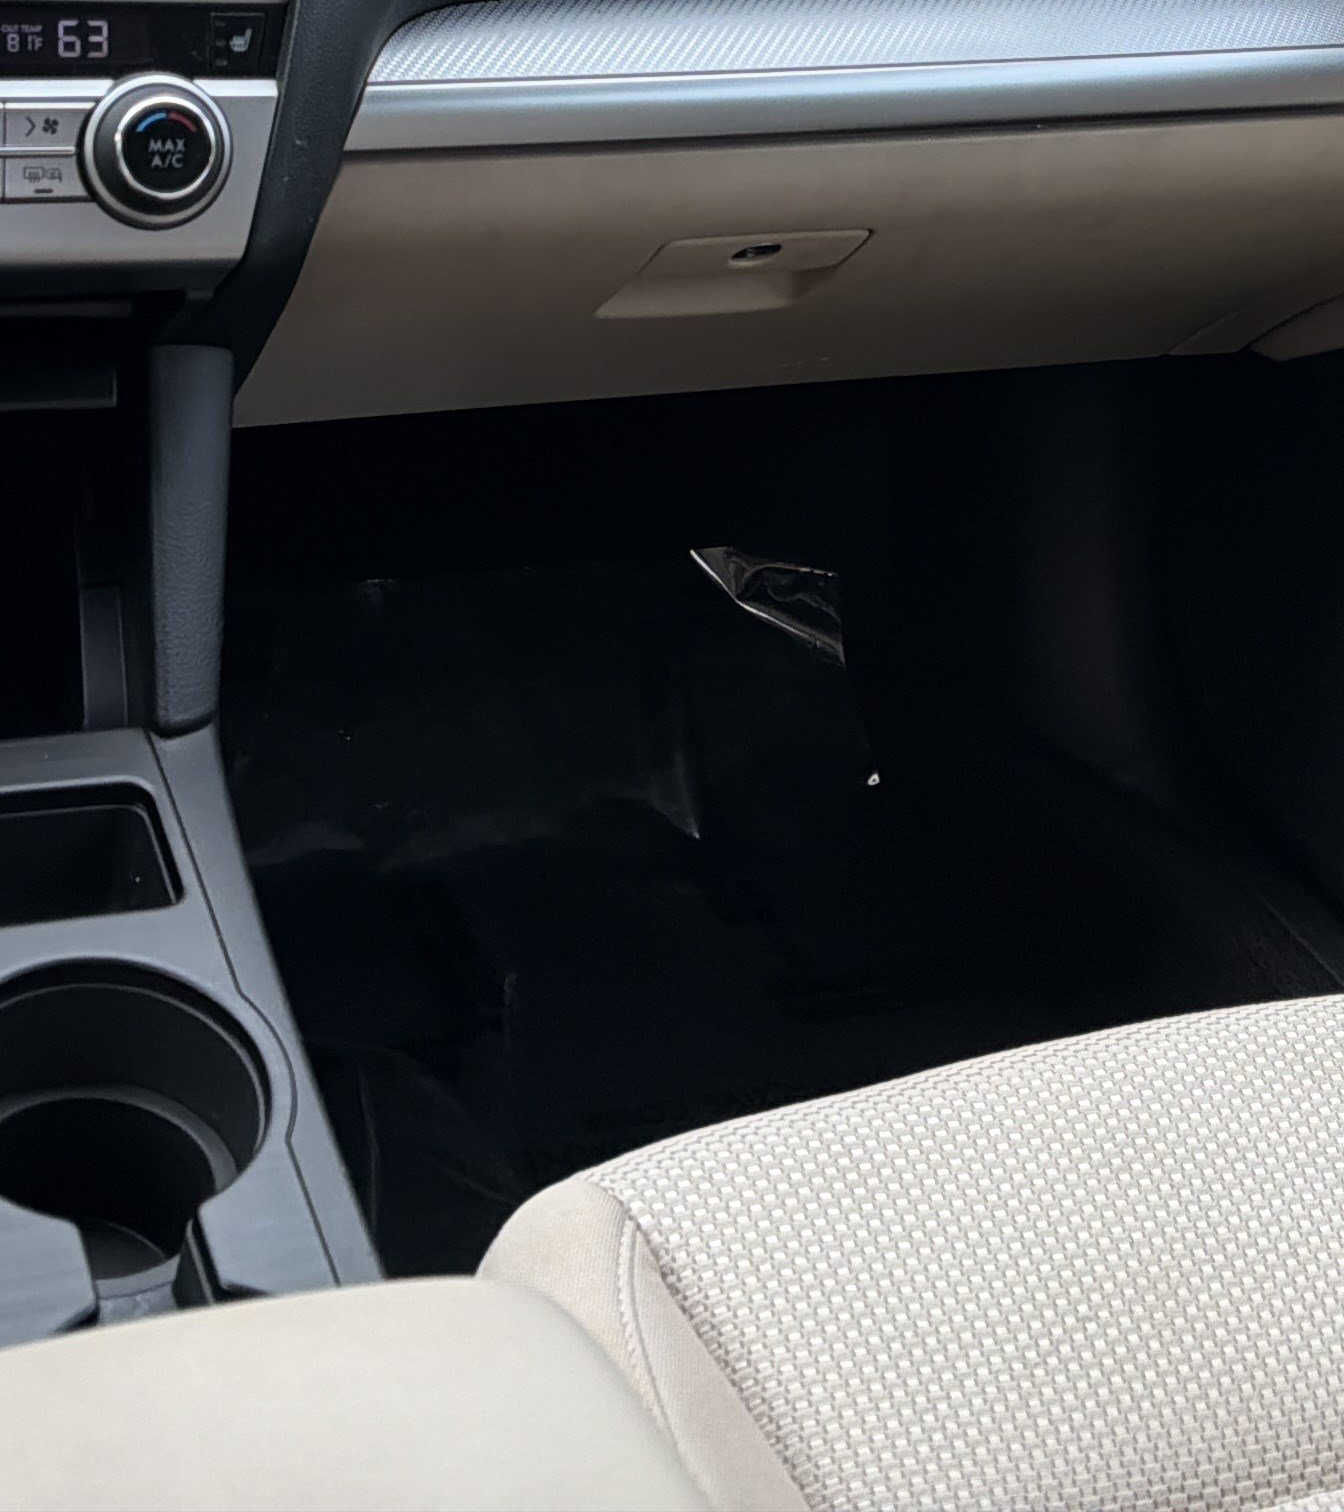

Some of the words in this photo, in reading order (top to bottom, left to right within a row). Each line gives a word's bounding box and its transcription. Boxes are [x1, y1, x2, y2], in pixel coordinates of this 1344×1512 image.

[58, 20, 109, 58] 63
[148, 138, 186, 153] MAX
[151, 153, 183, 168] A/C
